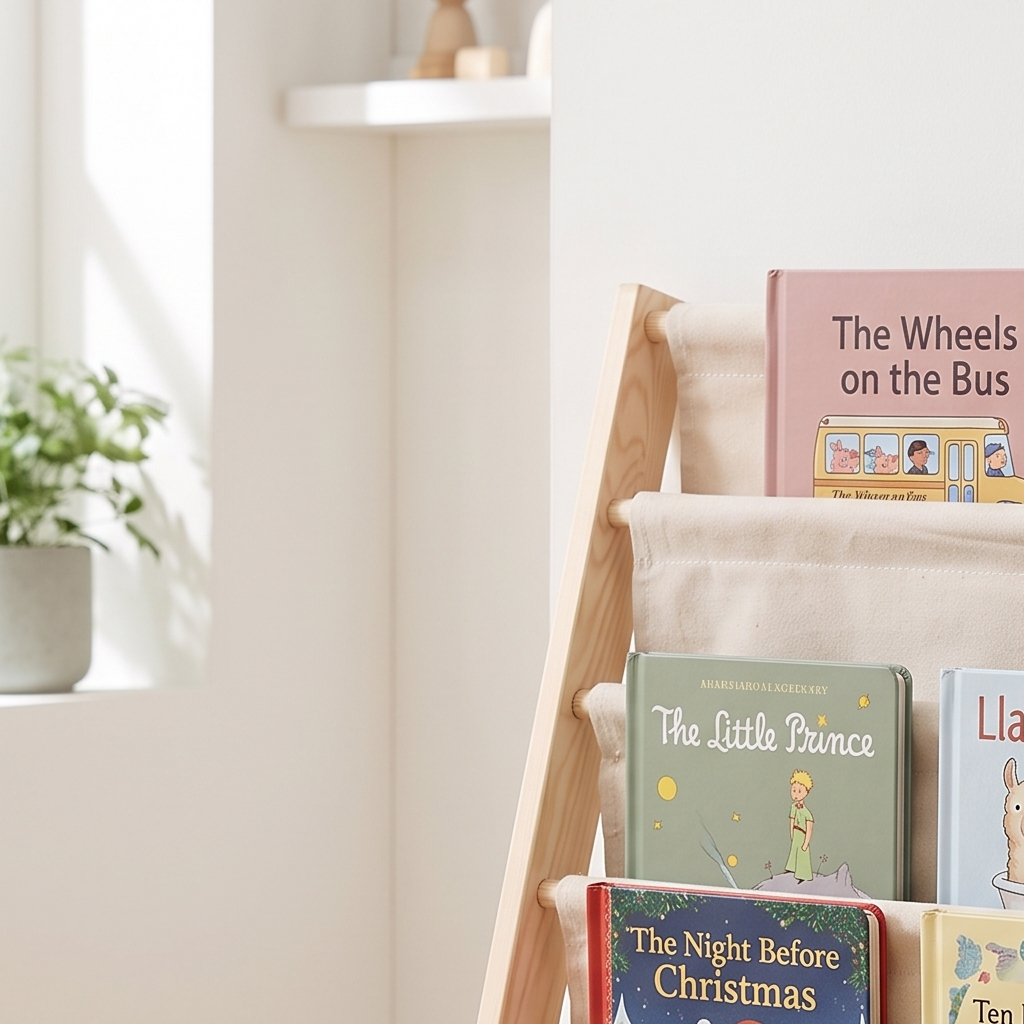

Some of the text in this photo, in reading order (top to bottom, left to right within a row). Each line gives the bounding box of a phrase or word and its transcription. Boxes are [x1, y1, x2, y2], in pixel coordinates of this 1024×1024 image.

[832, 315, 1018, 351] The Wheels
[841, 360, 1010, 396] on the Bus
[652, 705, 875, 757] The Little Prince
[630, 926, 840, 970] The Night Before
[654, 964, 816, 1011] Christmas
